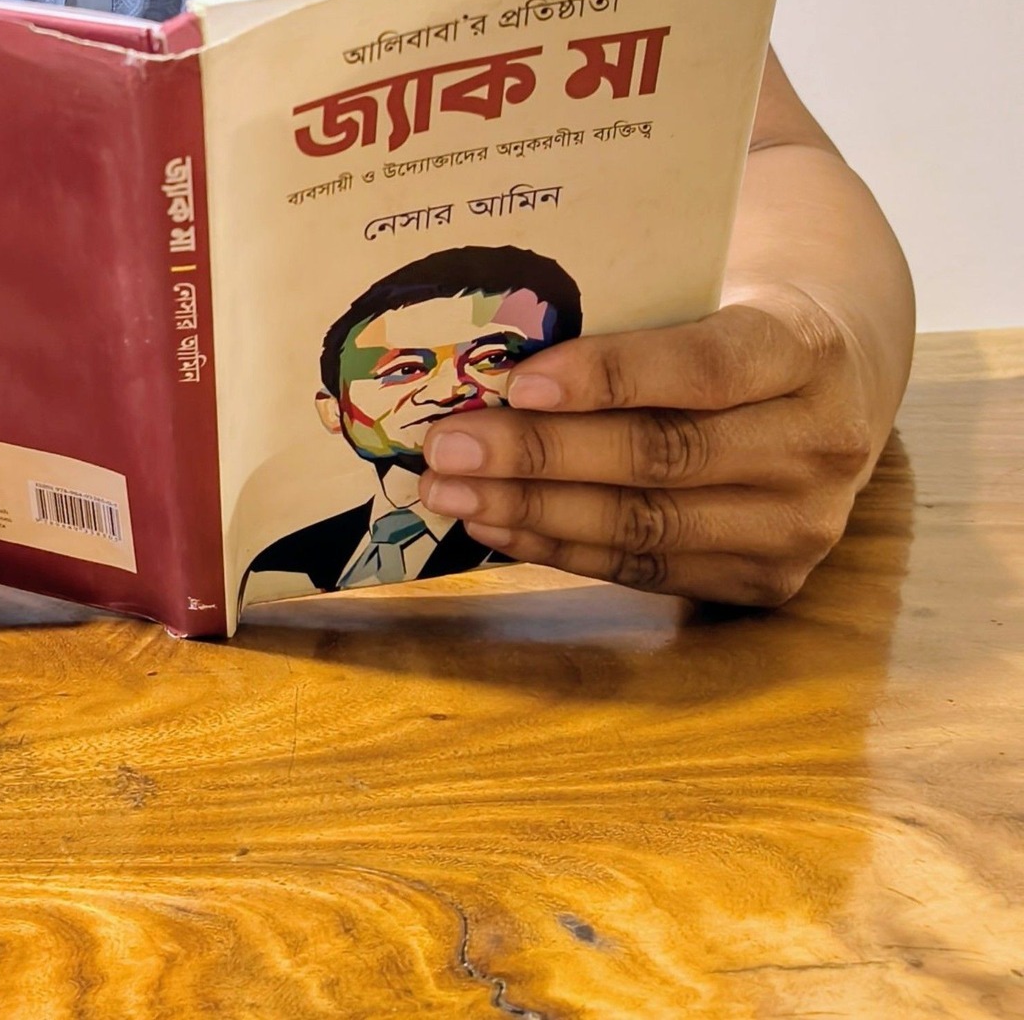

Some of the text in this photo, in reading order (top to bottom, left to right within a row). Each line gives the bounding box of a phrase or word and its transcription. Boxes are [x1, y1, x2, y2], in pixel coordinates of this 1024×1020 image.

[293, 26, 671, 157] জ্যাক মা
[161, 155, 196, 253] জ্যাক মা
[287, 120, 653, 205] ব্যবসায়ী ও উদ্যোক্তাদের অনুকরণীয় ব্যক্তিত্ব
[364, 183, 563, 240] নেসার আমিন
[173, 282, 207, 383] নেসার আমিন
